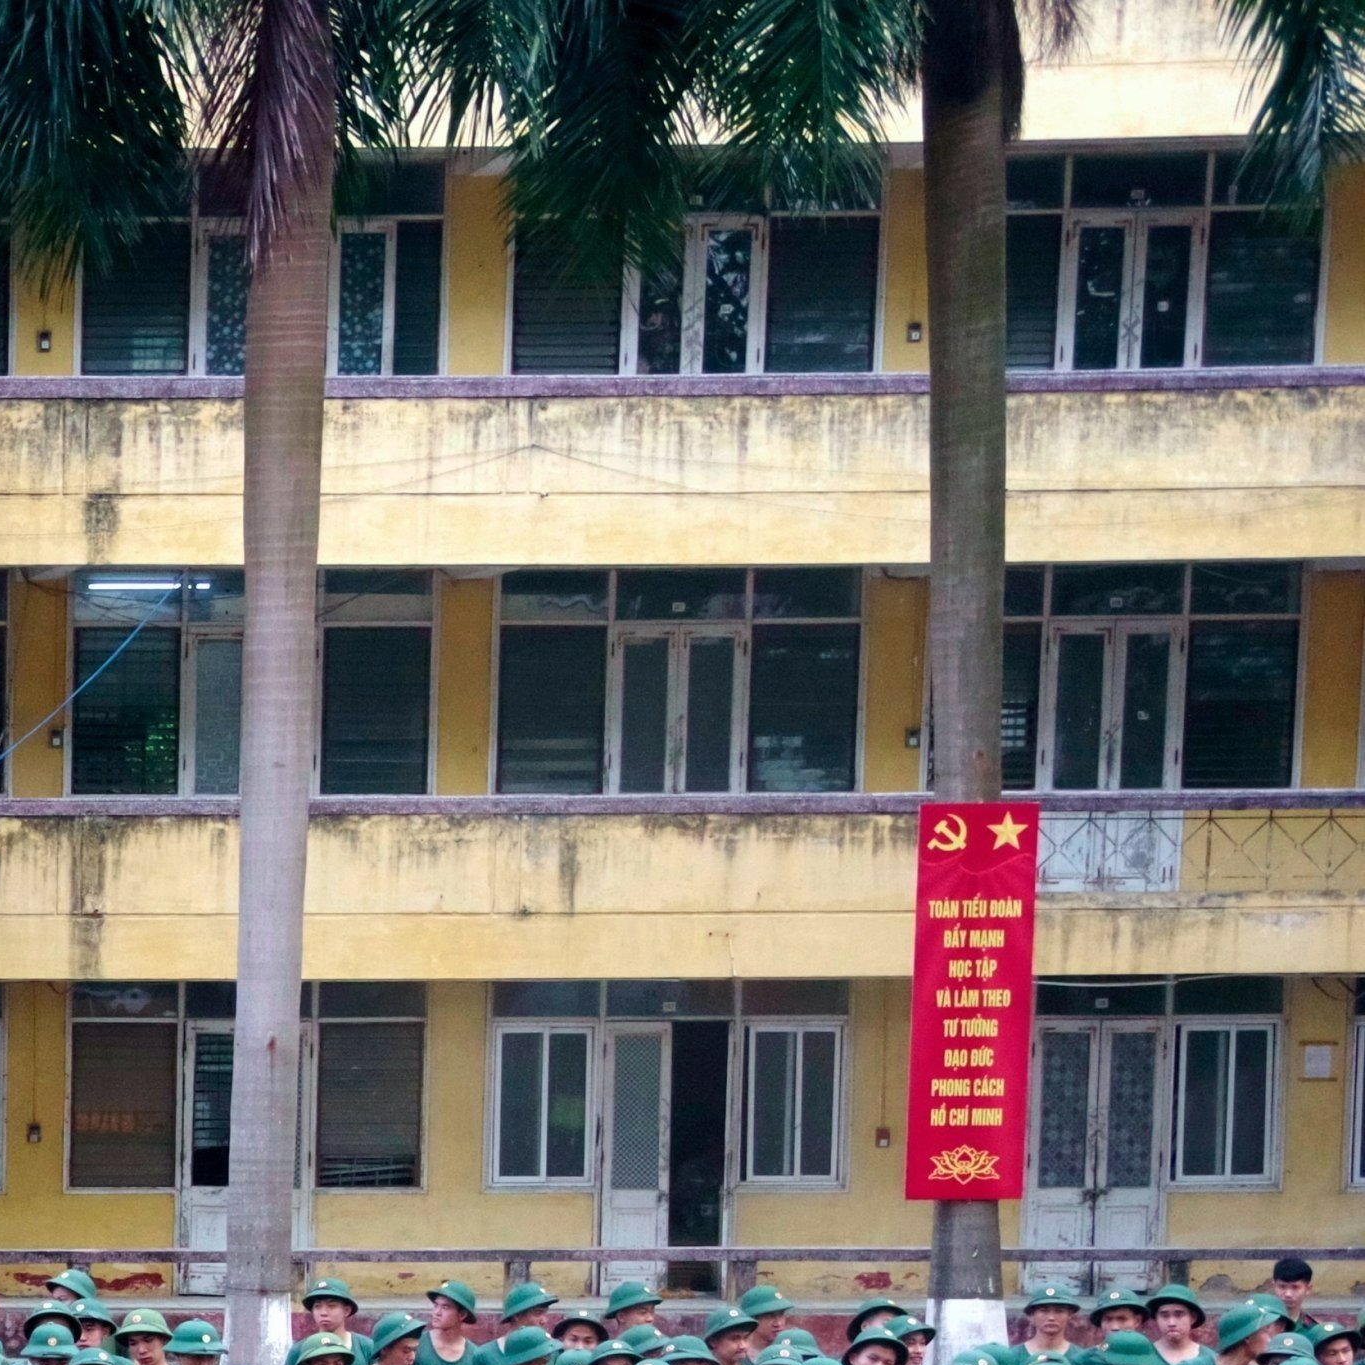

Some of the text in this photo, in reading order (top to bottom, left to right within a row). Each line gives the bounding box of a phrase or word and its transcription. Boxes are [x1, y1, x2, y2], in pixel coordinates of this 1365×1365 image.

[928, 892, 1022, 919] TOÀN TIỂU ĐOÀN
[943, 922, 1005, 952] ĐẨY MẠNH
[948, 956, 998, 982] HỌC TẬP
[936, 986, 1011, 1008] VÀ LÀM THEO
[943, 1013, 999, 1038] TƯ TƯỞNG
[943, 1045, 994, 1071] ĐẠO ĐỨC
[931, 1074, 1005, 1097] PHONG CÁCH
[949, 1104, 969, 1126] CHÍ
[971, 1108, 1003, 1126] MINH
